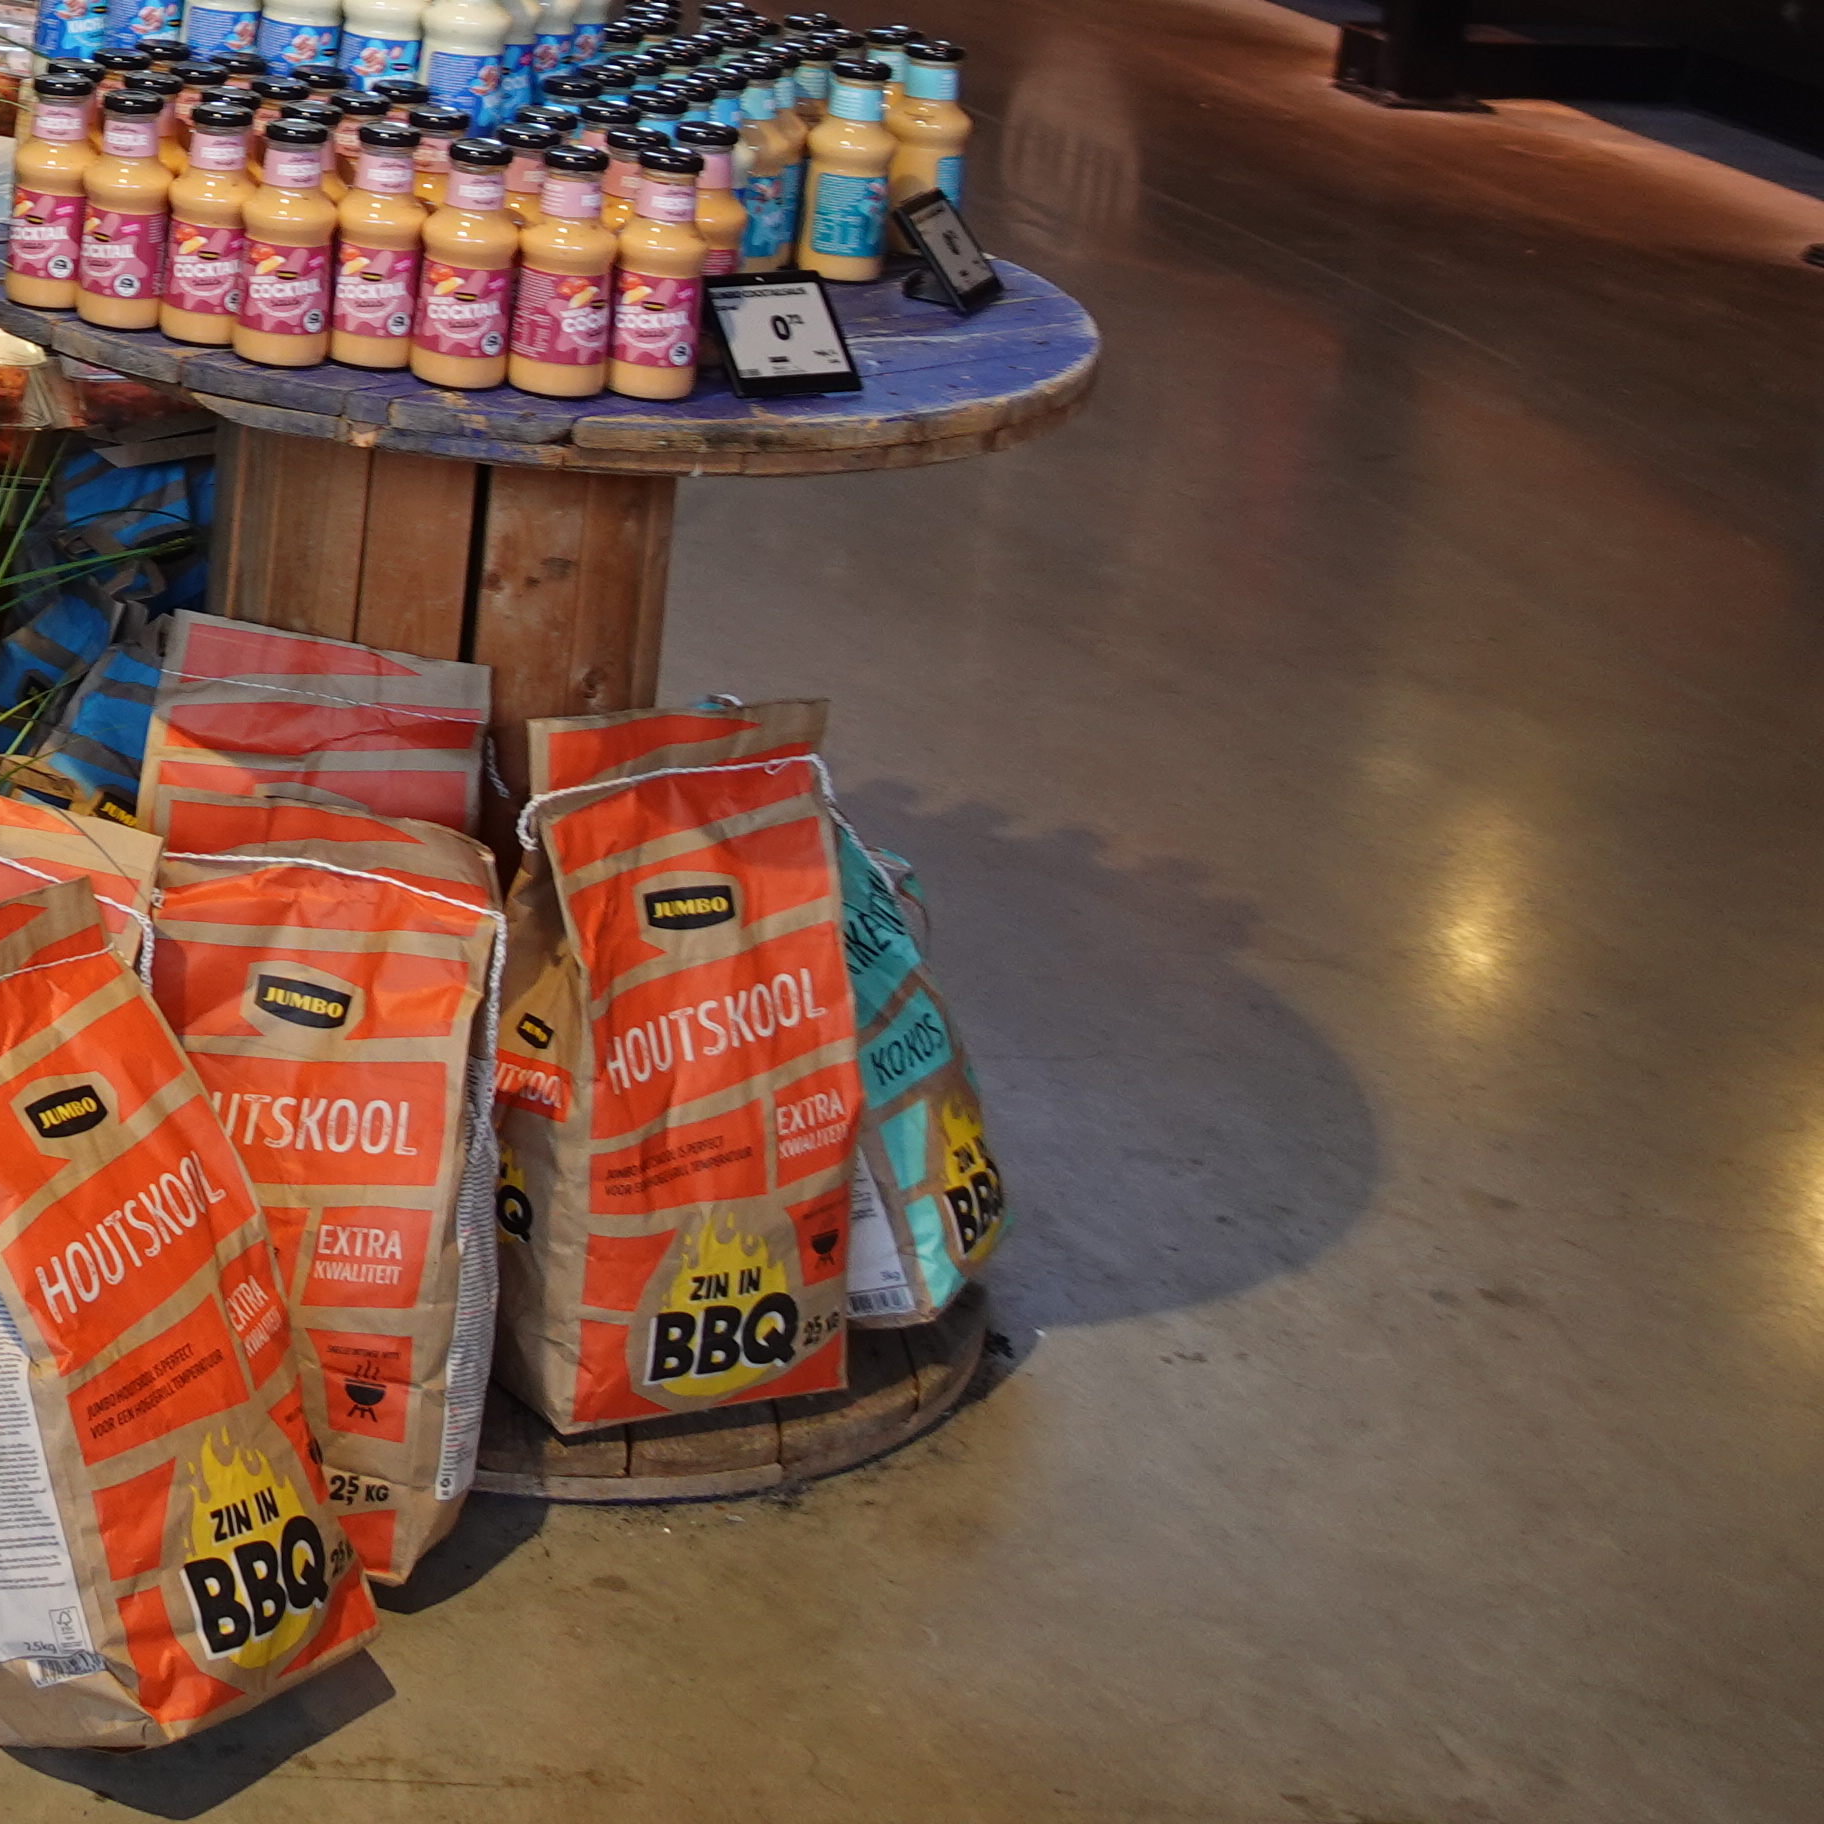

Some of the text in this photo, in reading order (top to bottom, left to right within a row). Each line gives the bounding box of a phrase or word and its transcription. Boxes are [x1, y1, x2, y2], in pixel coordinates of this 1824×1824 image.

[250, 280, 323, 300] COCKTAIL
[427, 301, 502, 321] COCKTAIL
[651, 894, 730, 920] JUMBO
[262, 984, 345, 1020] JUMBO
[603, 966, 831, 1097] HOUTSKOOL
[870, 1010, 945, 1086] KOKOS
[38, 1095, 99, 1131] JUMBO
[776, 1087, 846, 1137] EXTRA
[34, 1148, 228, 1325] HOUTSKOOL
[317, 1223, 404, 1262] EXTRA
[313, 1259, 404, 1286] KWALITEIT
[688, 1265, 763, 1304] ZIN IN
[226, 1276, 269, 1333] EXTRA
[645, 1290, 802, 1388] BBQ
[364, 1482, 390, 1503] KG
[209, 1487, 280, 1543] ZIN IN
[180, 1513, 331, 1661] BBQ
